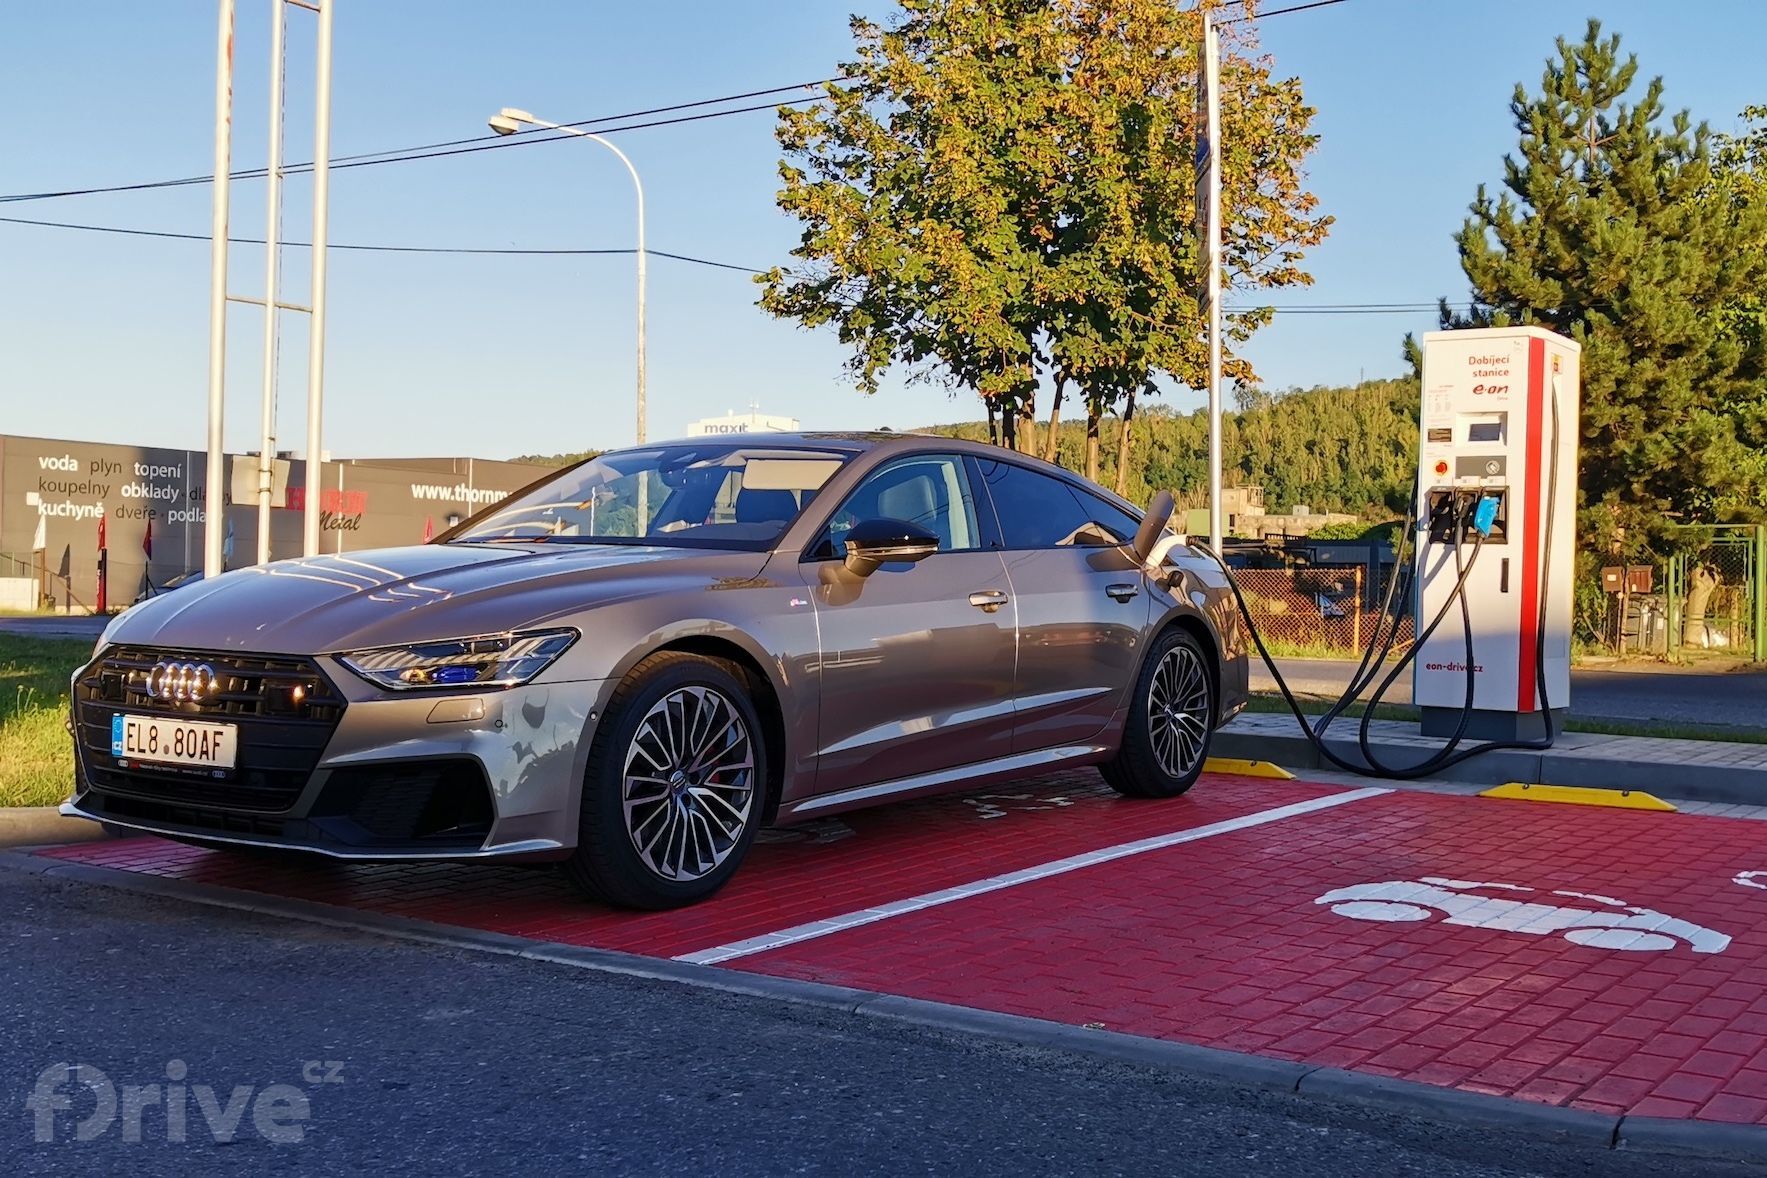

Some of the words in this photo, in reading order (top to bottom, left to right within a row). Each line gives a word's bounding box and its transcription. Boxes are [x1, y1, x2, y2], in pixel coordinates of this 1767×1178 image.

[1472, 369, 1509, 377] stanice
[704, 422, 749, 434] maxit
[38, 454, 79, 472] voda
[90, 458, 122, 476] plyn
[134, 462, 181, 479] topení
[38, 477, 110, 499] koupelny
[121, 482, 180, 503] obklady
[411, 482, 513, 504] www.thornm
[37, 498, 105, 521] kuchyně
[115, 504, 157, 520] dveře
[168, 507, 207, 524] podla
[320, 510, 361, 531] Metal
[127, 723, 158, 754] EL8
[174, 728, 223, 761] 80AF
